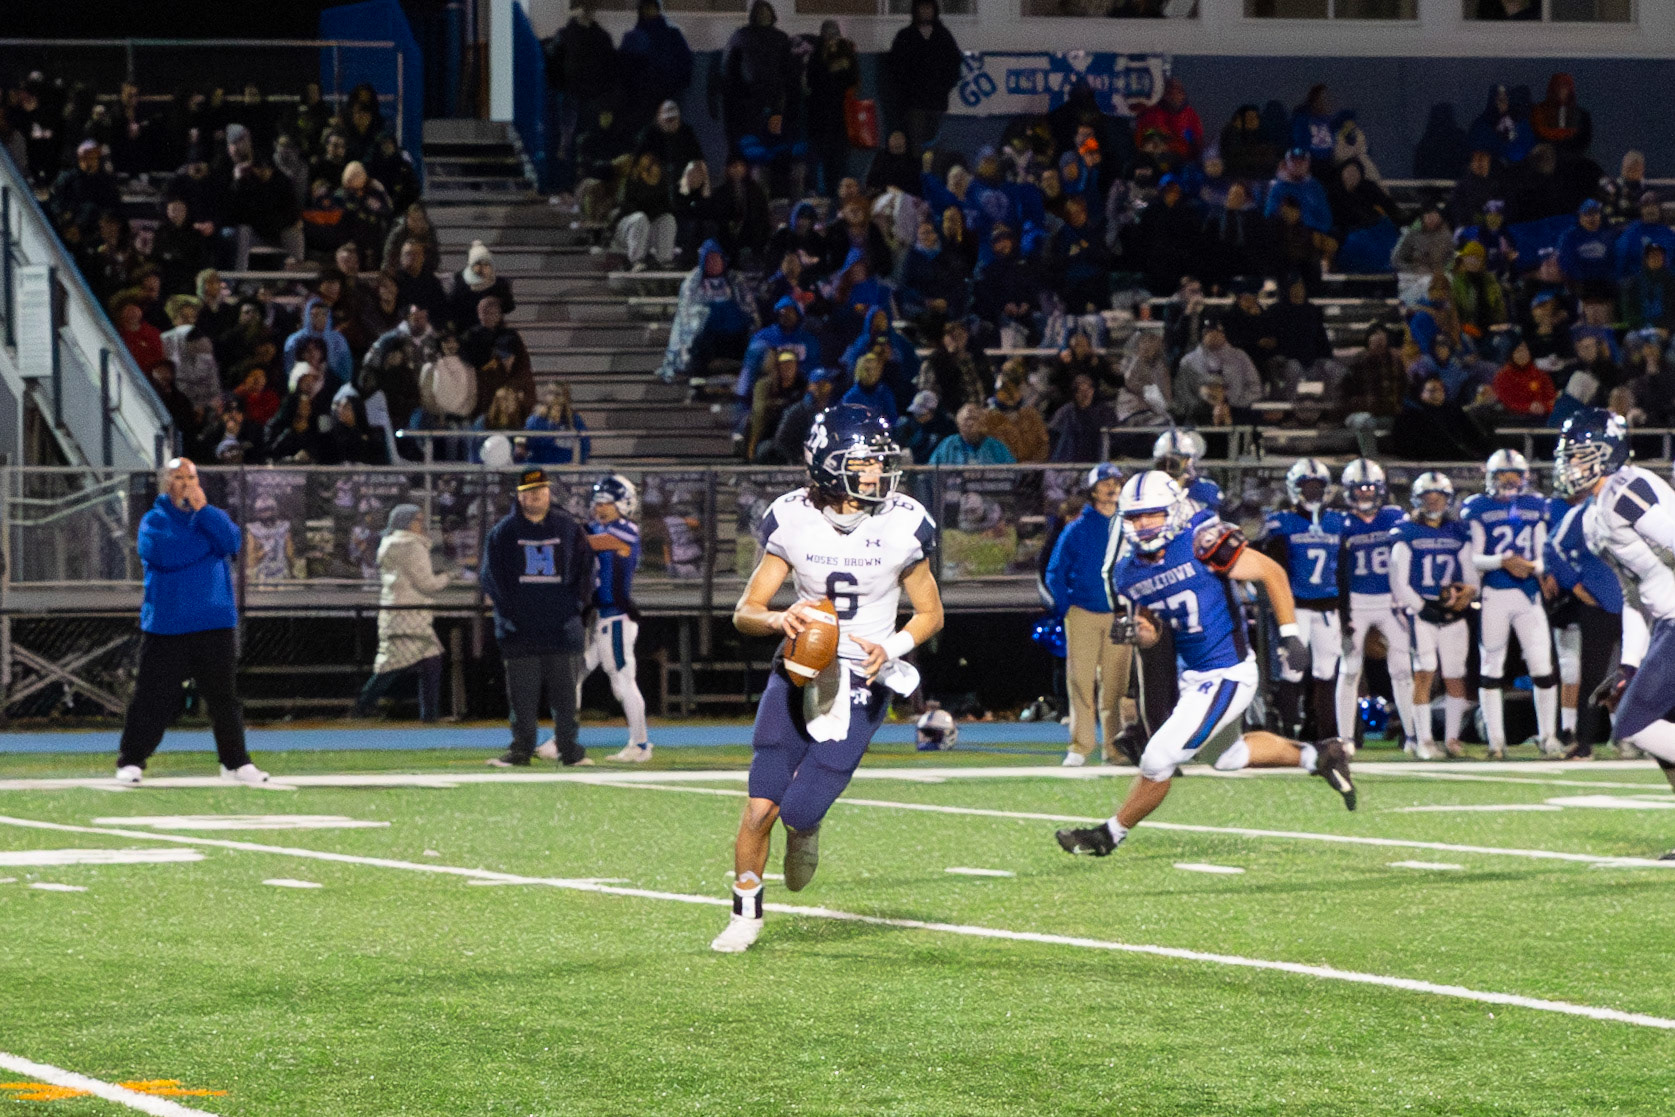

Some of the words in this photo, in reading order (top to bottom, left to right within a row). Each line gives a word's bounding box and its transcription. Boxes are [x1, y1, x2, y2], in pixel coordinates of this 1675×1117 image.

[959, 71, 997, 107] GO
[805, 553, 839, 566] MOSES
[843, 556, 882, 567] BROWN
[1492, 525, 1532, 561] 24
[1307, 549, 1327, 584] 7
[1421, 554, 1456, 587] 17
[825, 571, 859, 620] 6
